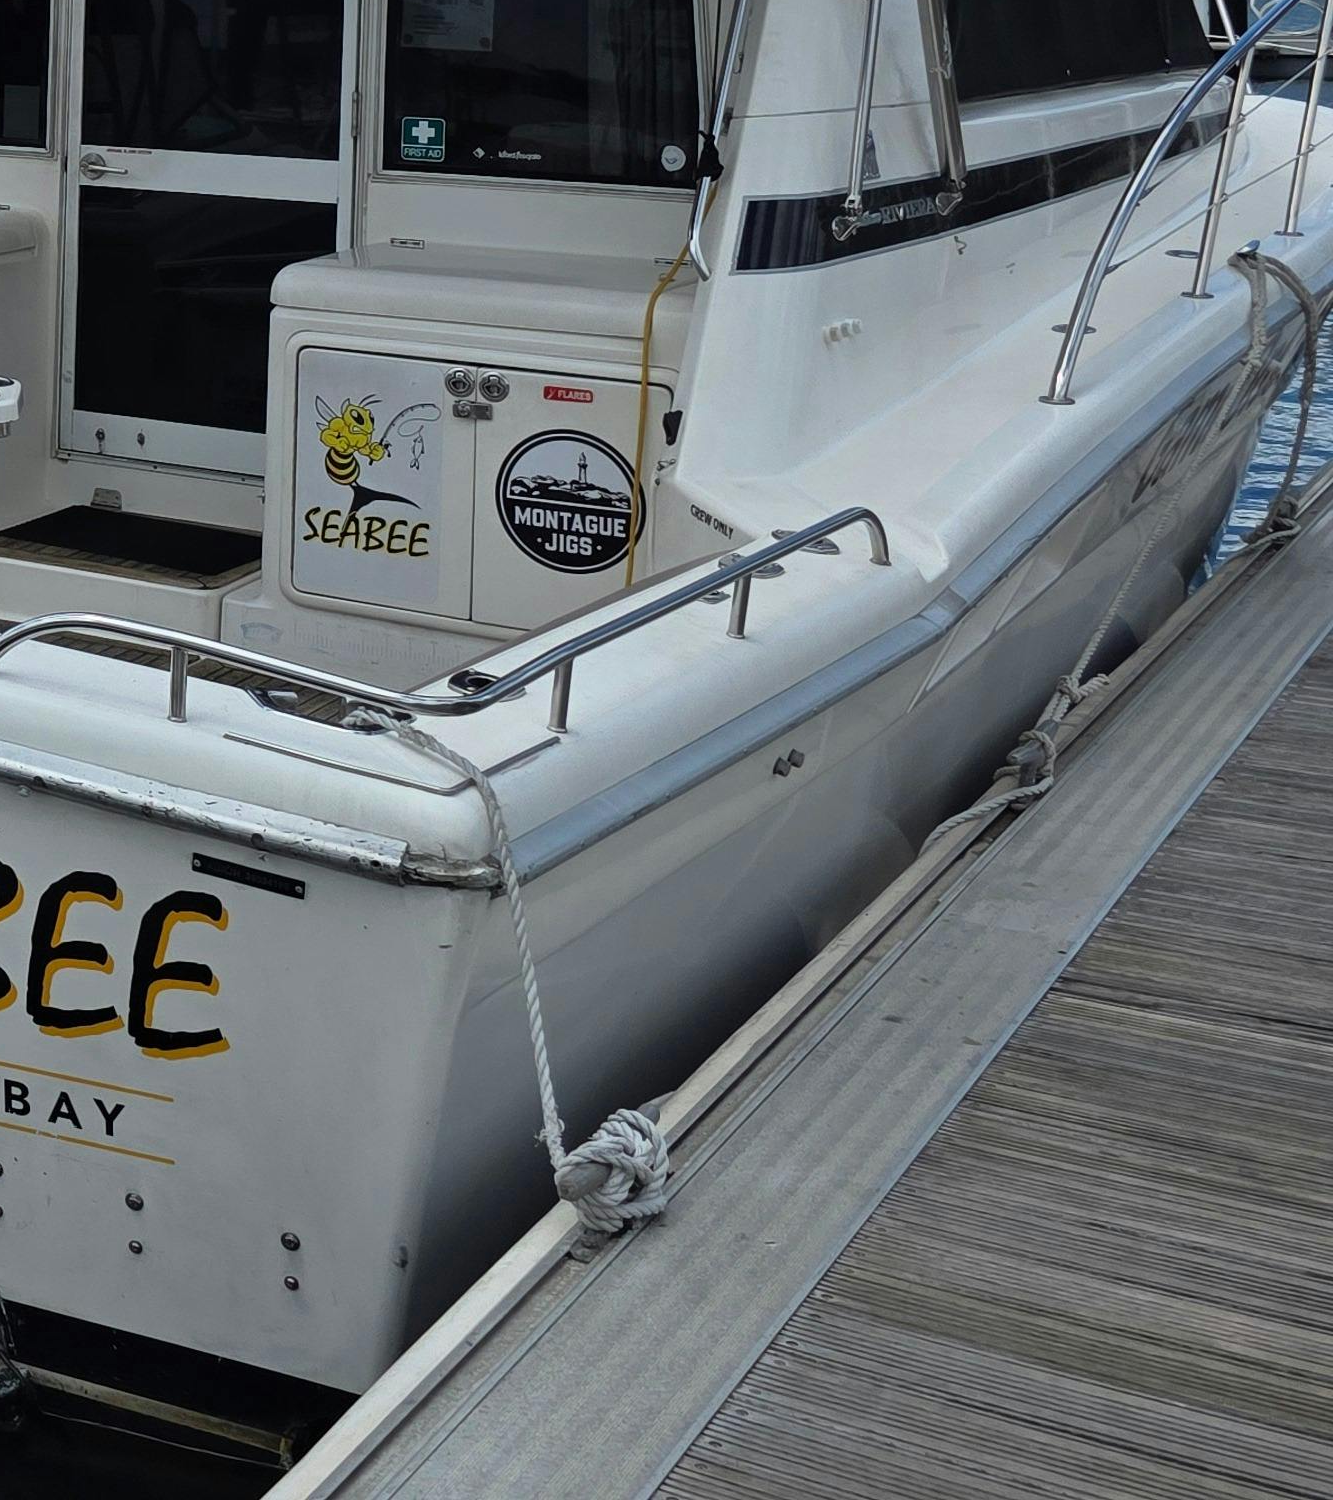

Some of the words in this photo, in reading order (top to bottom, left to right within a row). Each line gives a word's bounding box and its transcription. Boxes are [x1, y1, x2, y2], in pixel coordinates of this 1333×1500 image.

[403, 147, 426, 157] FIRST
[428, 149, 442, 158] AID
[558, 389, 591, 402] FLARES
[303, 506, 430, 557] SEABEE
[514, 505, 627, 538] MONTAGUE
[690, 504, 713, 526] CREW
[713, 518, 734, 540] ONLY
[545, 533, 593, 556] JIGS
[3, 1078, 125, 1137] BAY
